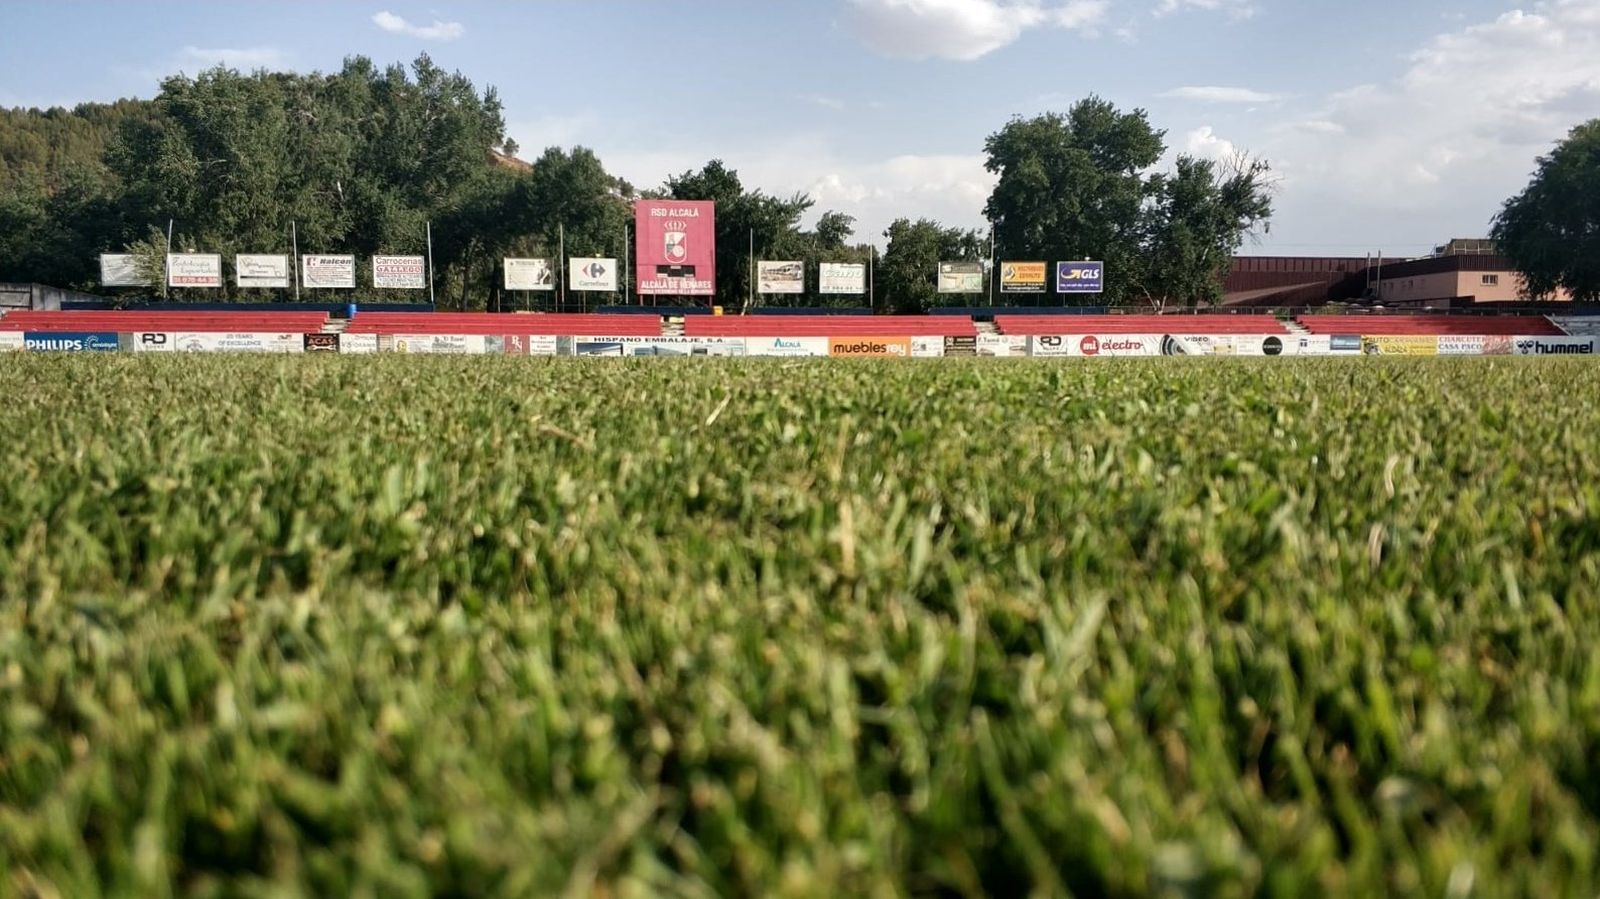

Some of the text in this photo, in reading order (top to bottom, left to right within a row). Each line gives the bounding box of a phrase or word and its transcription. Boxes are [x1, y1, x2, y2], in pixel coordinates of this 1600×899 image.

[650, 207, 667, 217] RSD
[1081, 268, 1100, 279] GLS
[26, 339, 82, 350] PHILIPS
[1535, 341, 1594, 354] hummel
